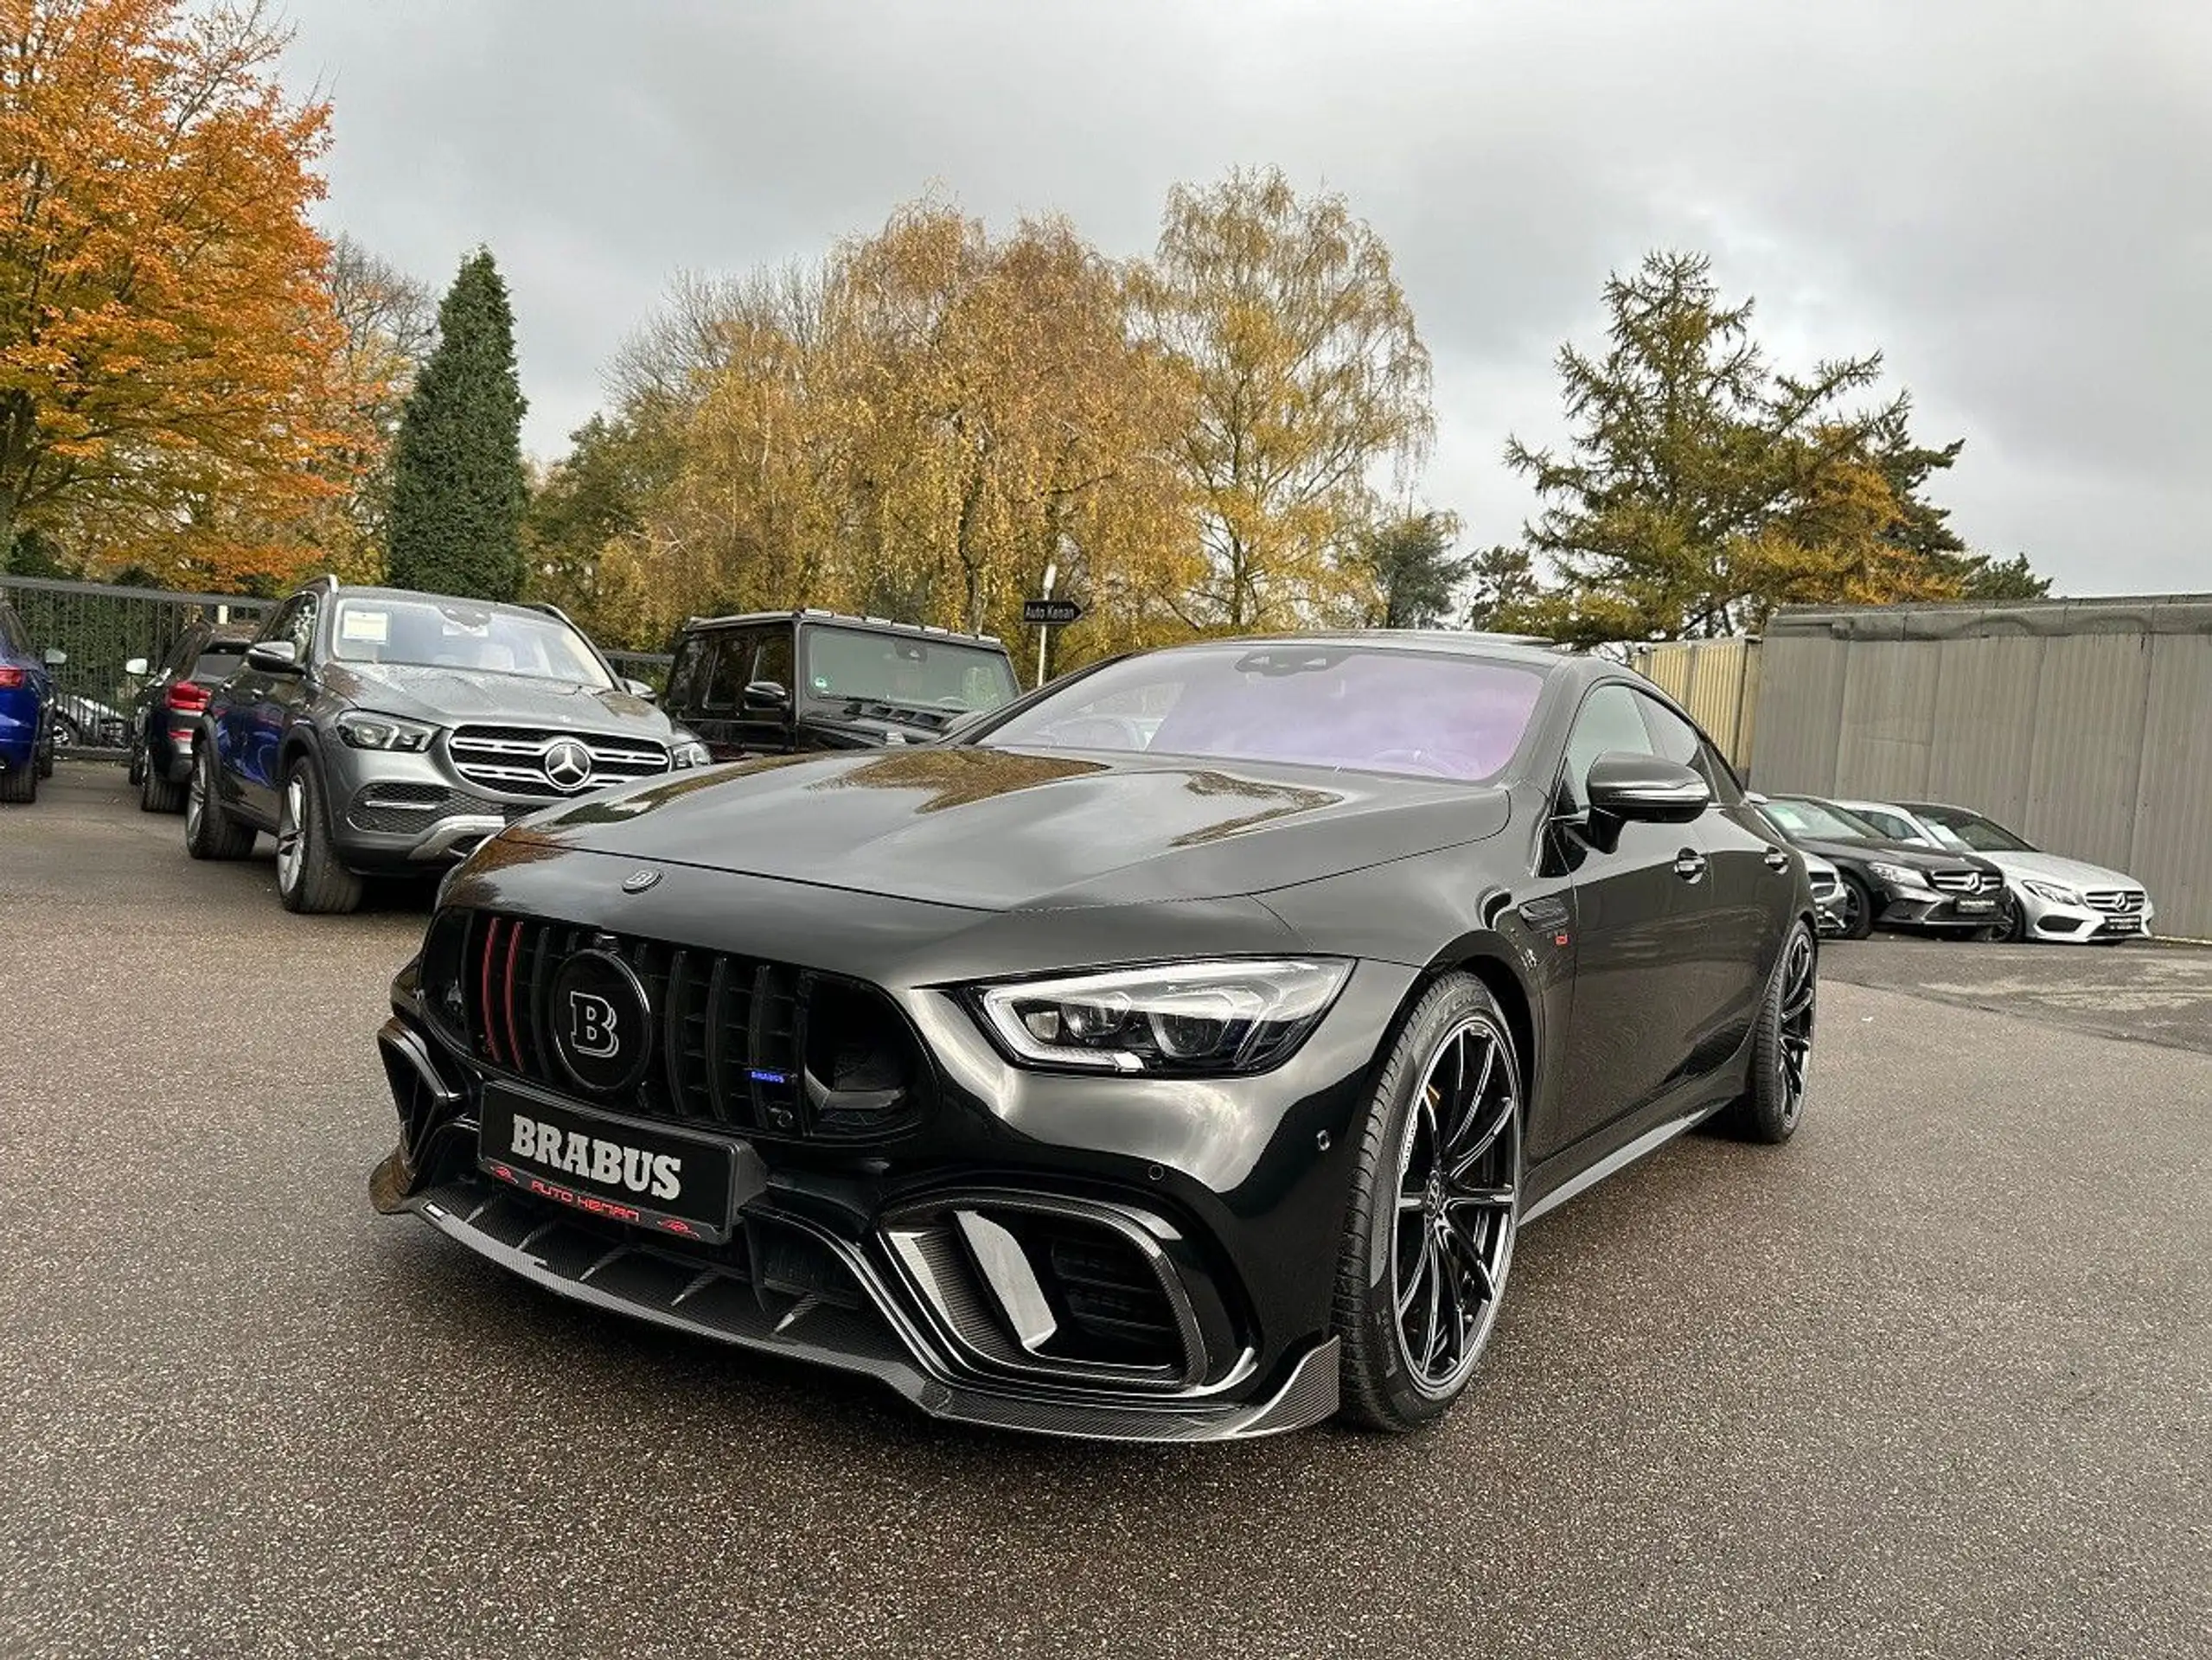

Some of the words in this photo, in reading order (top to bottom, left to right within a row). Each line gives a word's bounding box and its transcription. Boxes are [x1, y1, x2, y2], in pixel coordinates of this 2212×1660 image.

[1026, 605, 1045, 619] Auto
[1047, 605, 1074, 619] Kenan
[570, 991, 619, 1057] B
[510, 1114, 681, 1201] BRABUS
[531, 1180, 573, 1204] AUTO
